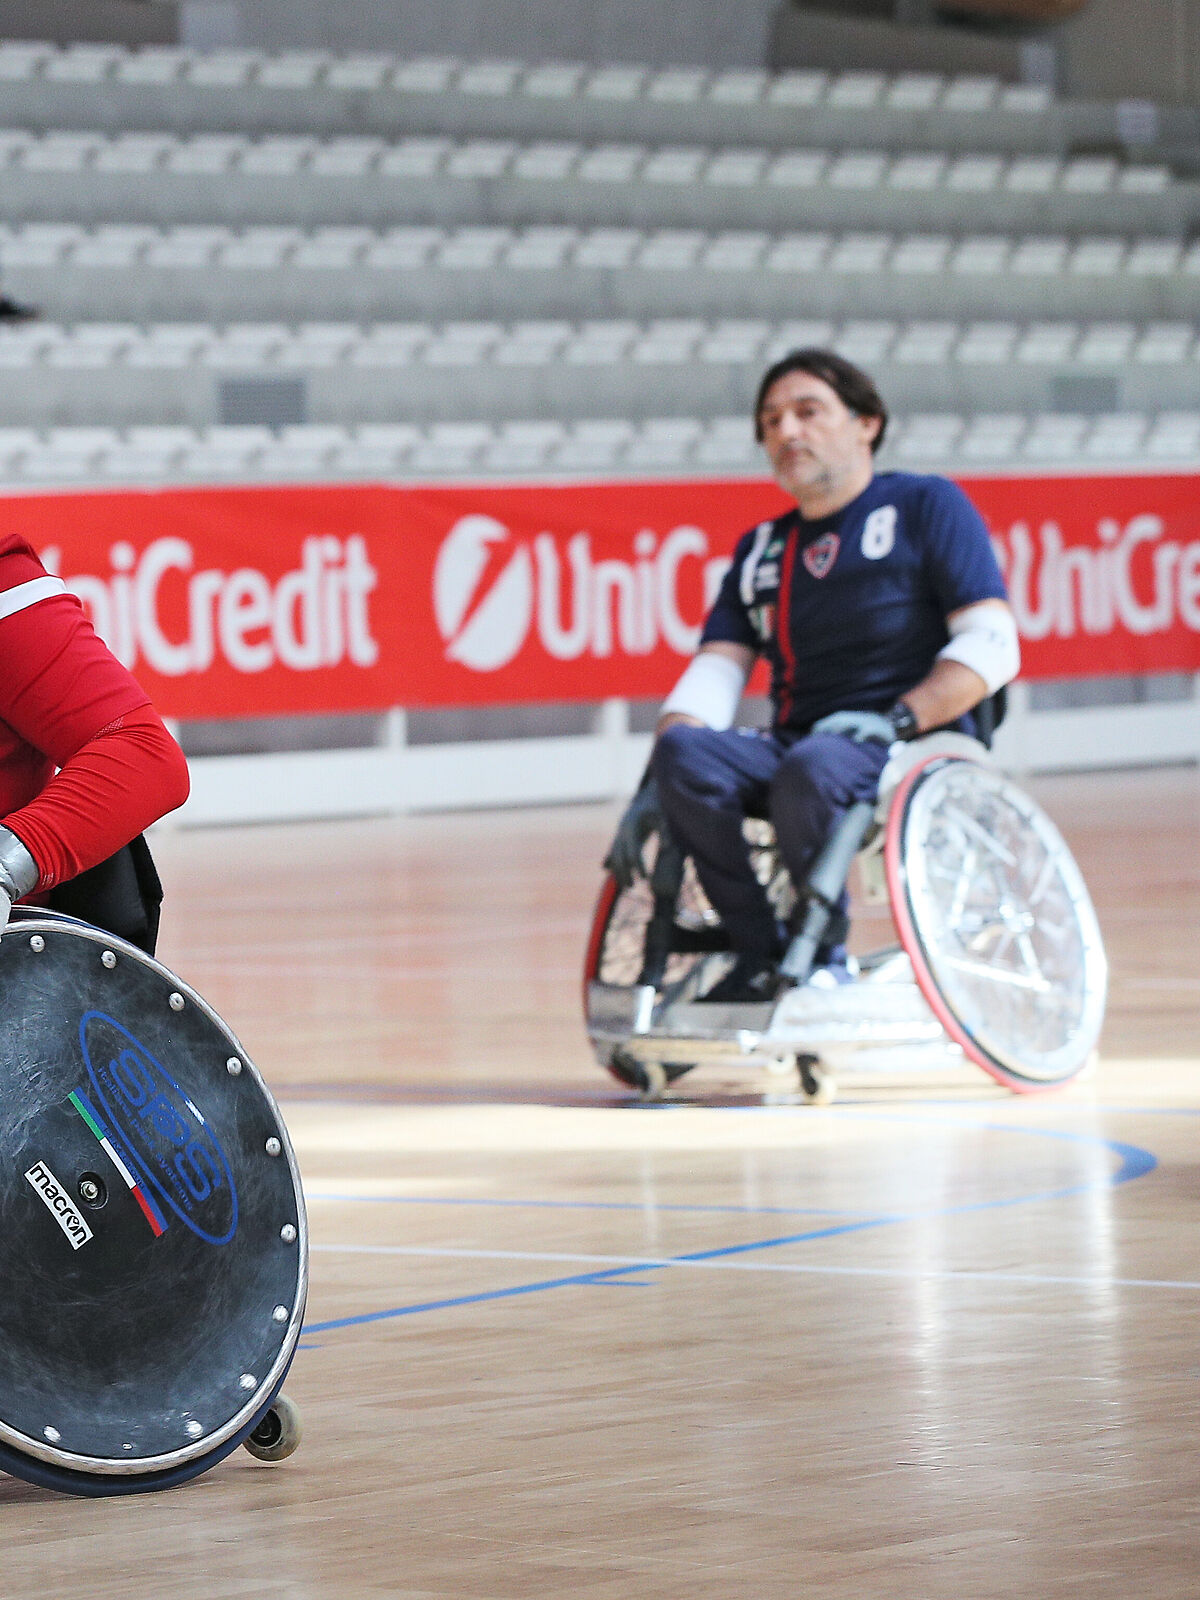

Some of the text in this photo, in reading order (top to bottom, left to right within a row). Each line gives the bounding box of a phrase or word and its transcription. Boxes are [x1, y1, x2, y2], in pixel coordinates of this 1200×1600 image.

[533, 524, 734, 661] UniCr
[860, 504, 898, 560] 8
[1008, 512, 1200, 640] UniCre
[40, 532, 378, 677] niCredit
[109, 1048, 222, 1202] SPS
[29, 1165, 87, 1245] macron
